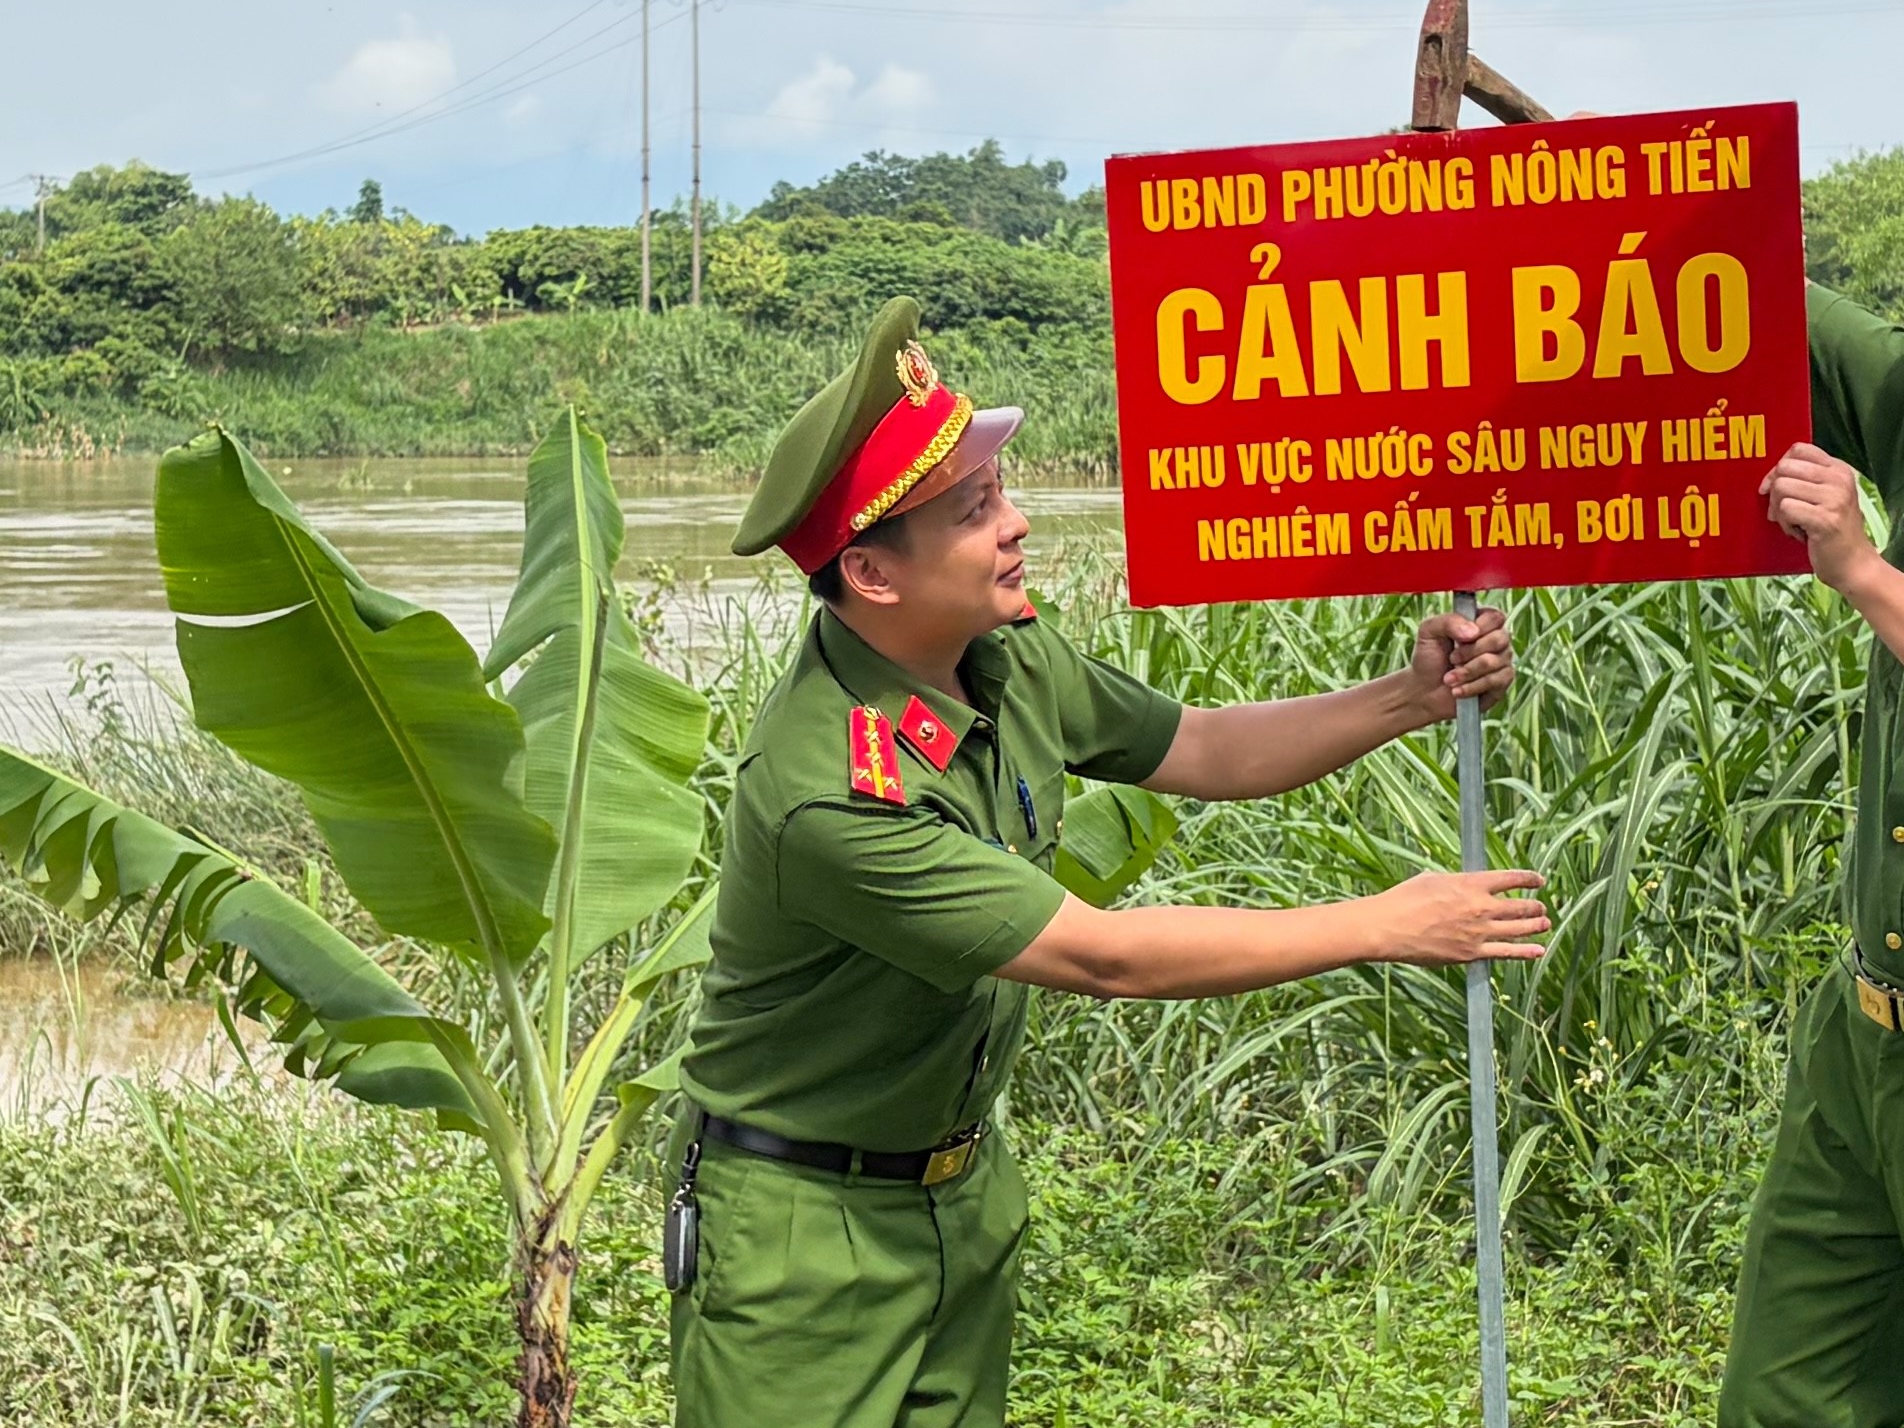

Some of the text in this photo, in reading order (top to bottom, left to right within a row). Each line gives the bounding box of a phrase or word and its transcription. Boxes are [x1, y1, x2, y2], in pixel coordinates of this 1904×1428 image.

[1140, 120, 1751, 233] UBND PHƯỜNG NÔNG TIẾN
[1156, 231, 1751, 405] CẢNH BÁO
[1148, 398, 1767, 494] KHU VỰC NƯỚC SÂU NGUY HIỂM
[1197, 485, 1721, 562] NGHIÊM CẤM TẮM, BƠI LỘI
